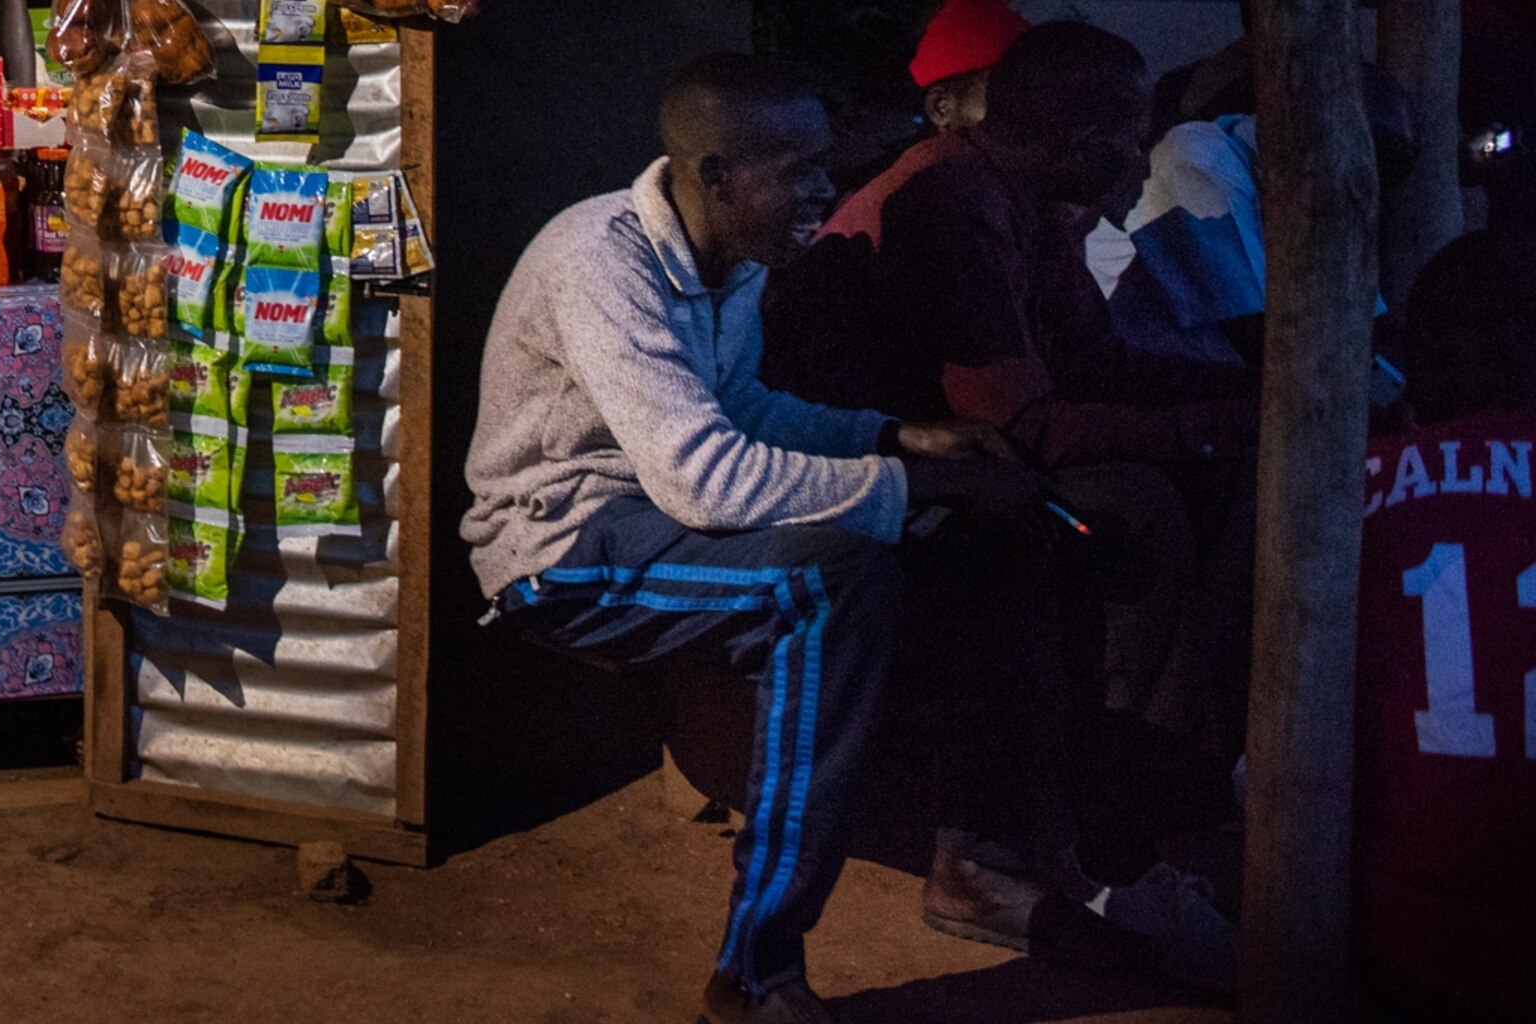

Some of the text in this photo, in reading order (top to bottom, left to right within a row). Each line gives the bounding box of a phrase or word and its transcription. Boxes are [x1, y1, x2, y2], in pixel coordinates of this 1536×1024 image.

[181, 157, 230, 186] NOMI
[260, 202, 315, 223] NOMI
[255, 302, 310, 324] NOMI
